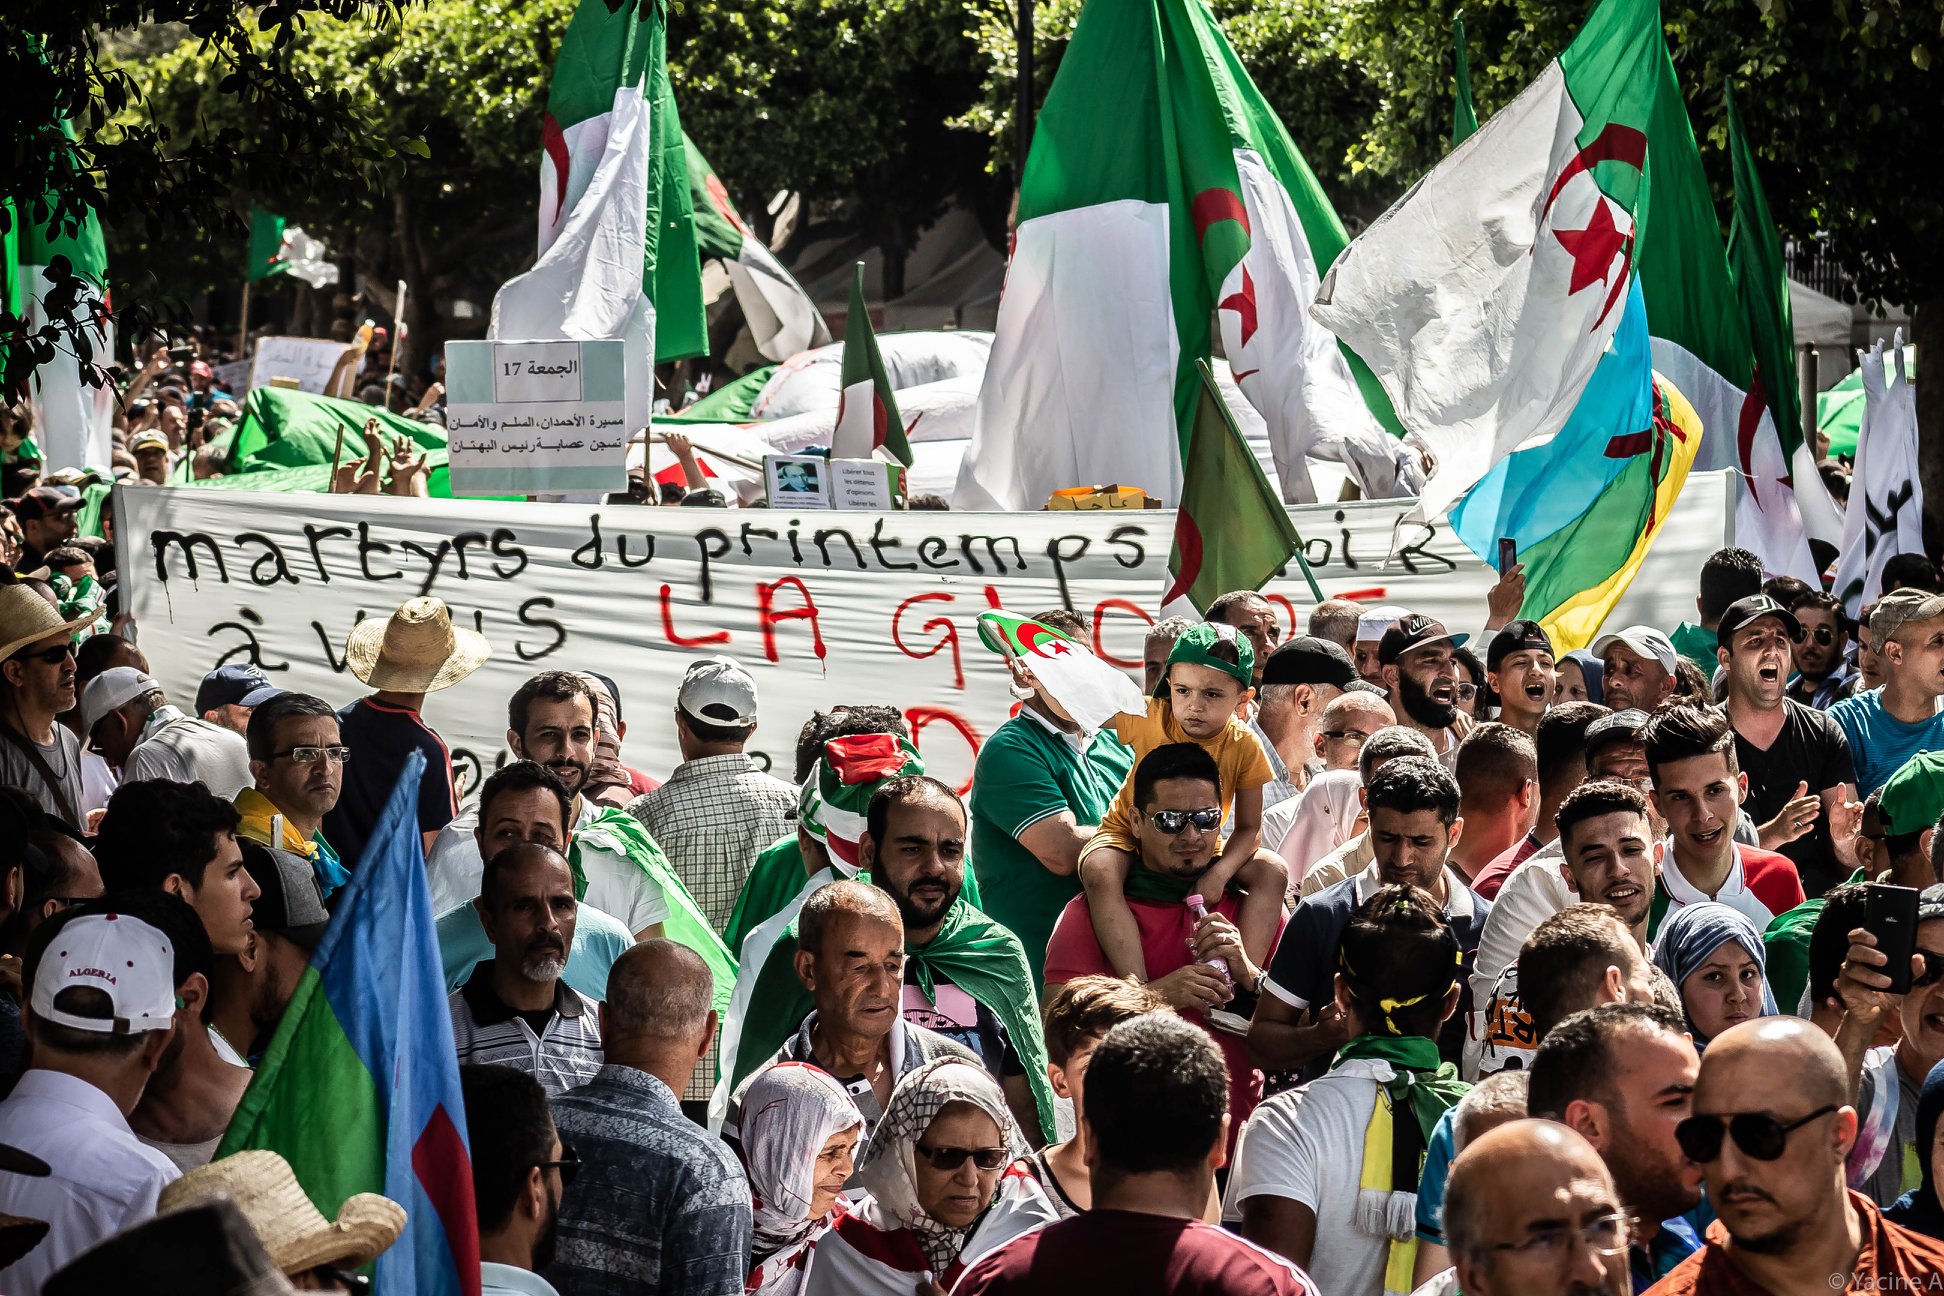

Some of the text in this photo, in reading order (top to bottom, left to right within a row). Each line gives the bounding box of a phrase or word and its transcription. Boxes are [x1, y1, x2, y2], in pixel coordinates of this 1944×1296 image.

[503, 360, 578, 378] الجمعة 17
[589, 414, 624, 429] مسيرة
[590, 437, 622, 452] تسجن
[151, 520, 529, 597] martyrs
[571, 514, 656, 570] du
[695, 518, 1148, 611] printemps
[207, 606, 290, 672] à
[659, 576, 828, 664] LA
[69, 968, 117, 985] ALGERIA
